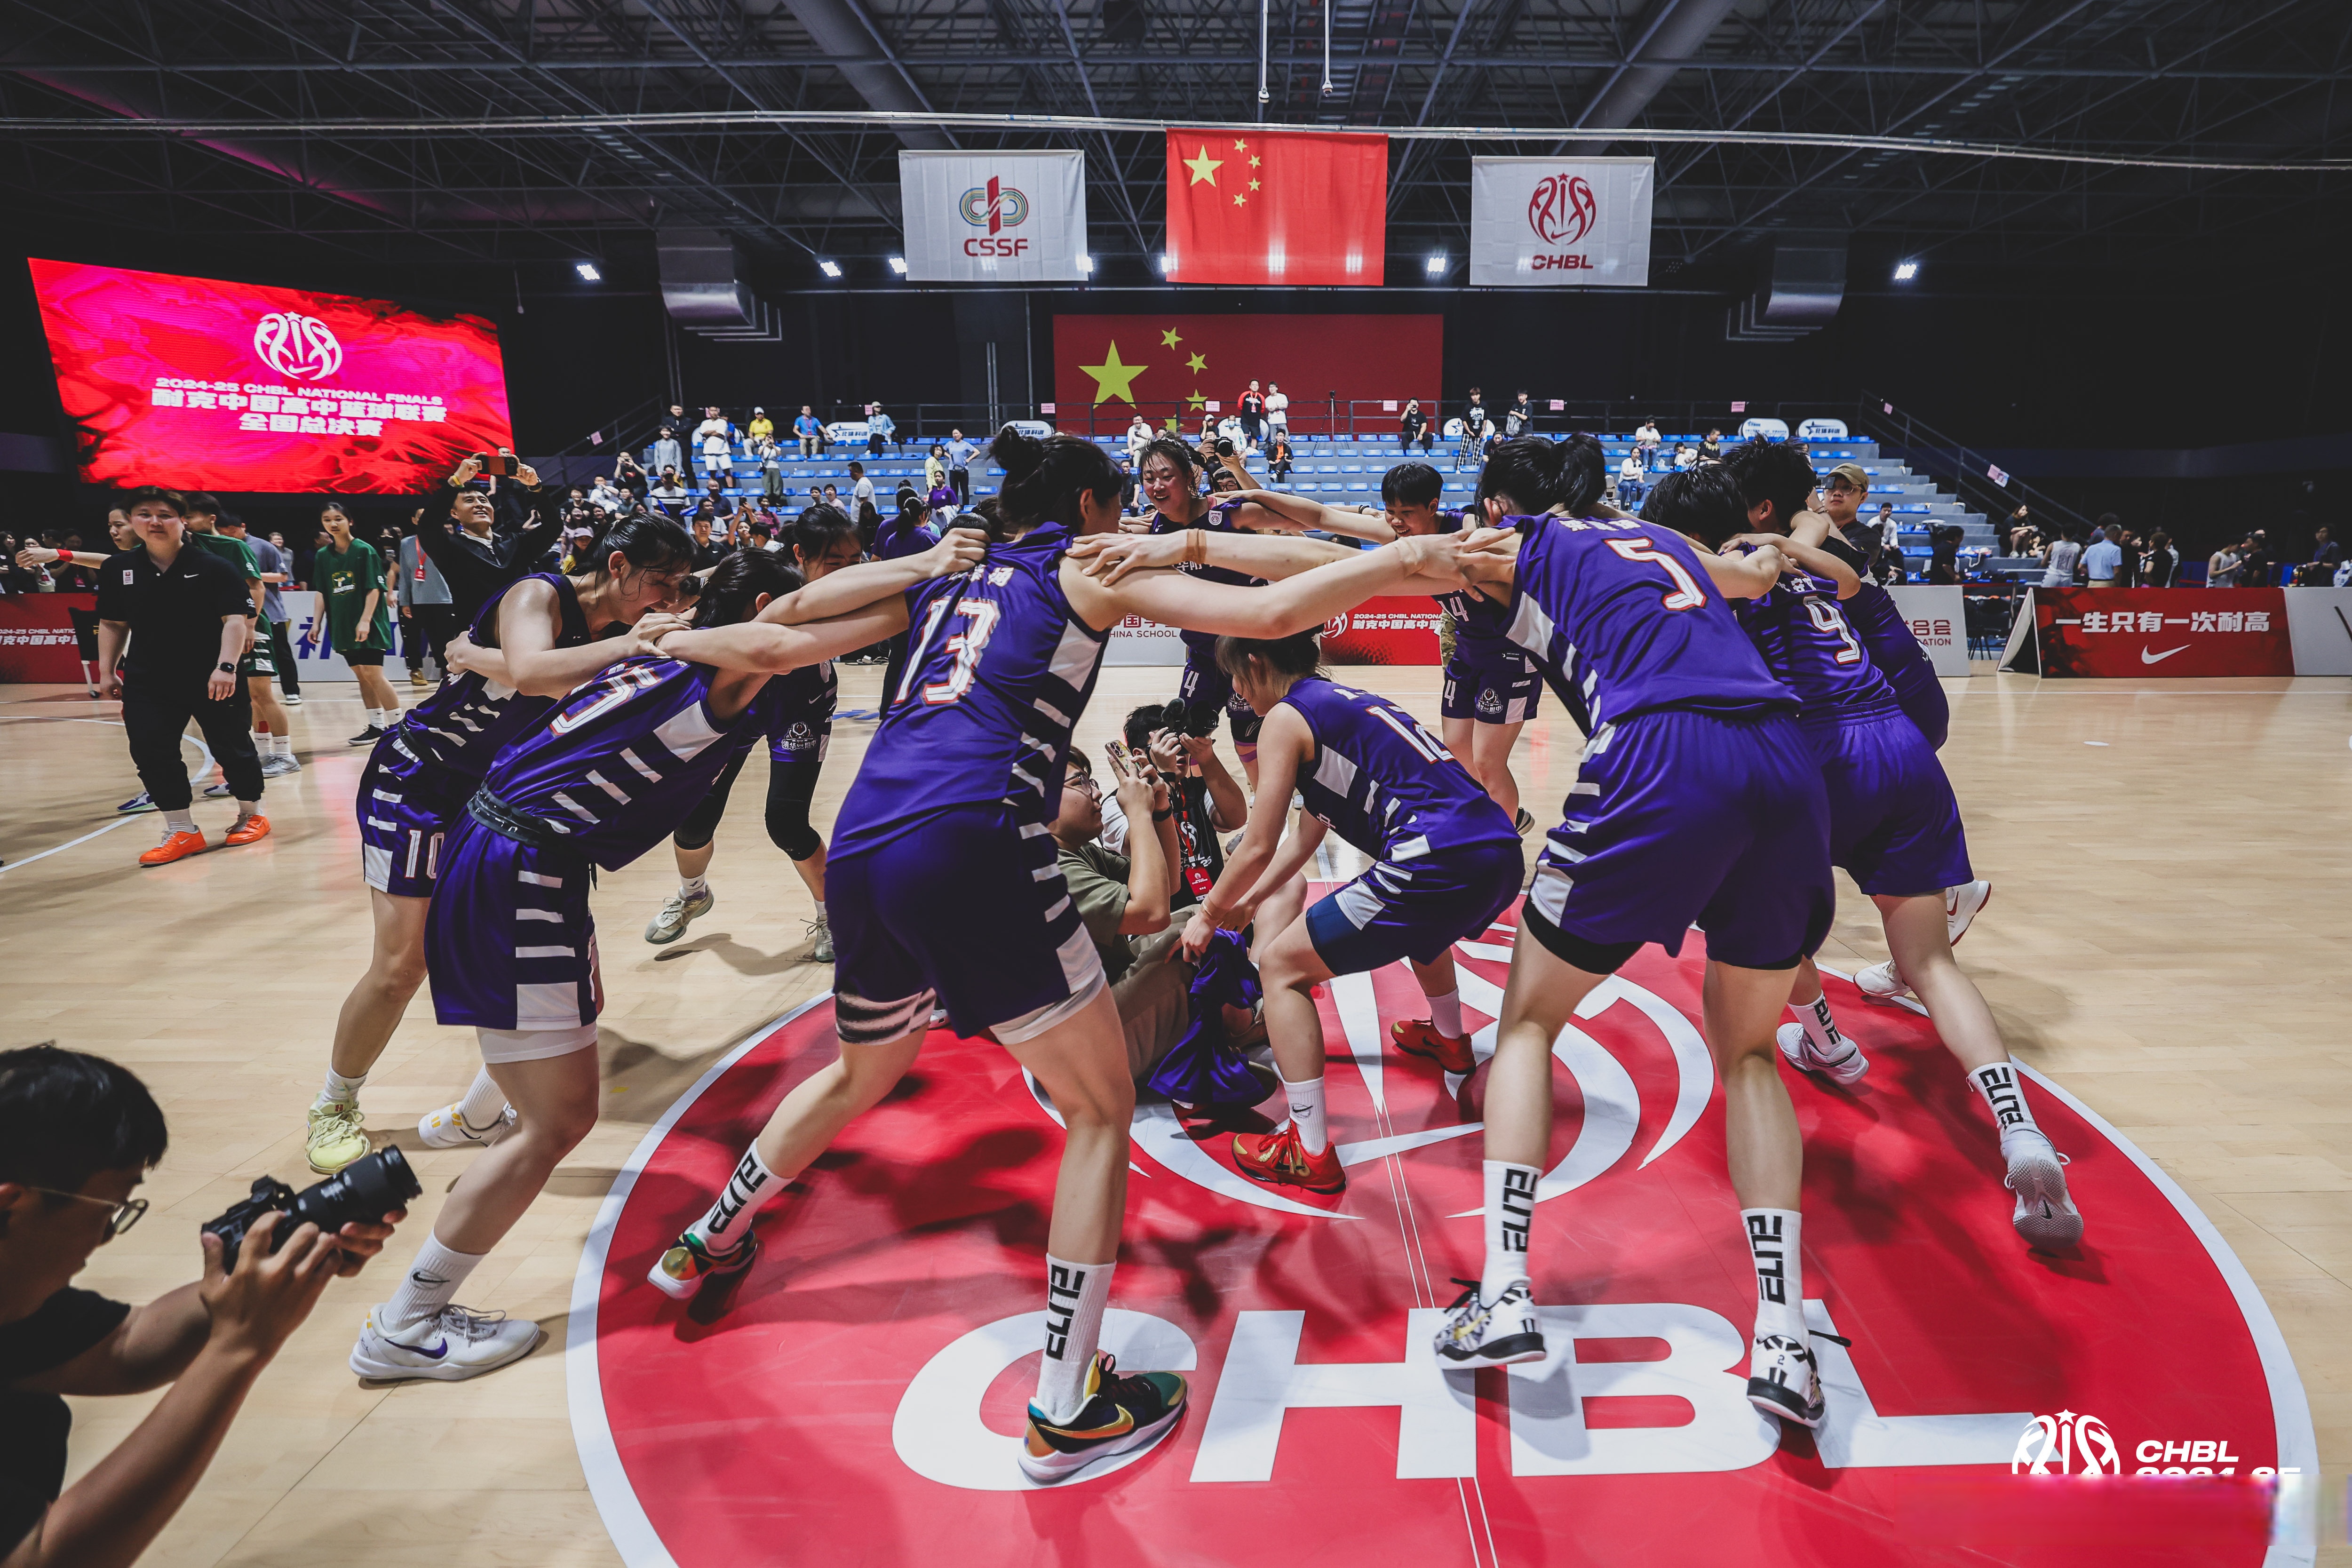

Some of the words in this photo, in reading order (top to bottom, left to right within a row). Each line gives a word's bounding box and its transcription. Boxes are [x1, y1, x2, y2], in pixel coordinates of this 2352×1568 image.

[964, 239, 1028, 257] CSSF
[1531, 255, 1594, 270] CHBL
[151, 388, 448, 422] 耐克中国高中篮球联赛
[156, 377, 239, 392] 2024-25
[243, 382, 294, 396] CHBL
[297, 387, 382, 402] NATIONAL
[385, 393, 443, 406] FINALS
[239, 412, 383, 437] 全国总决赛
[1604, 537, 1708, 611] 5
[1351, 620, 1442, 629] 耐克中国高中篮
[1803, 594, 1861, 665] 9
[1905, 620, 1951, 635] 合会
[2055, 612, 2271, 633] 一生只有一次耐高
[894, 596, 1001, 704] 13
[1184, 670, 1200, 698] 4
[1444, 679, 1456, 708] 4
[404, 829, 445, 879] 10
[1777, 1354, 1785, 1365] 2
[892, 1299, 2064, 1491] CHBL
